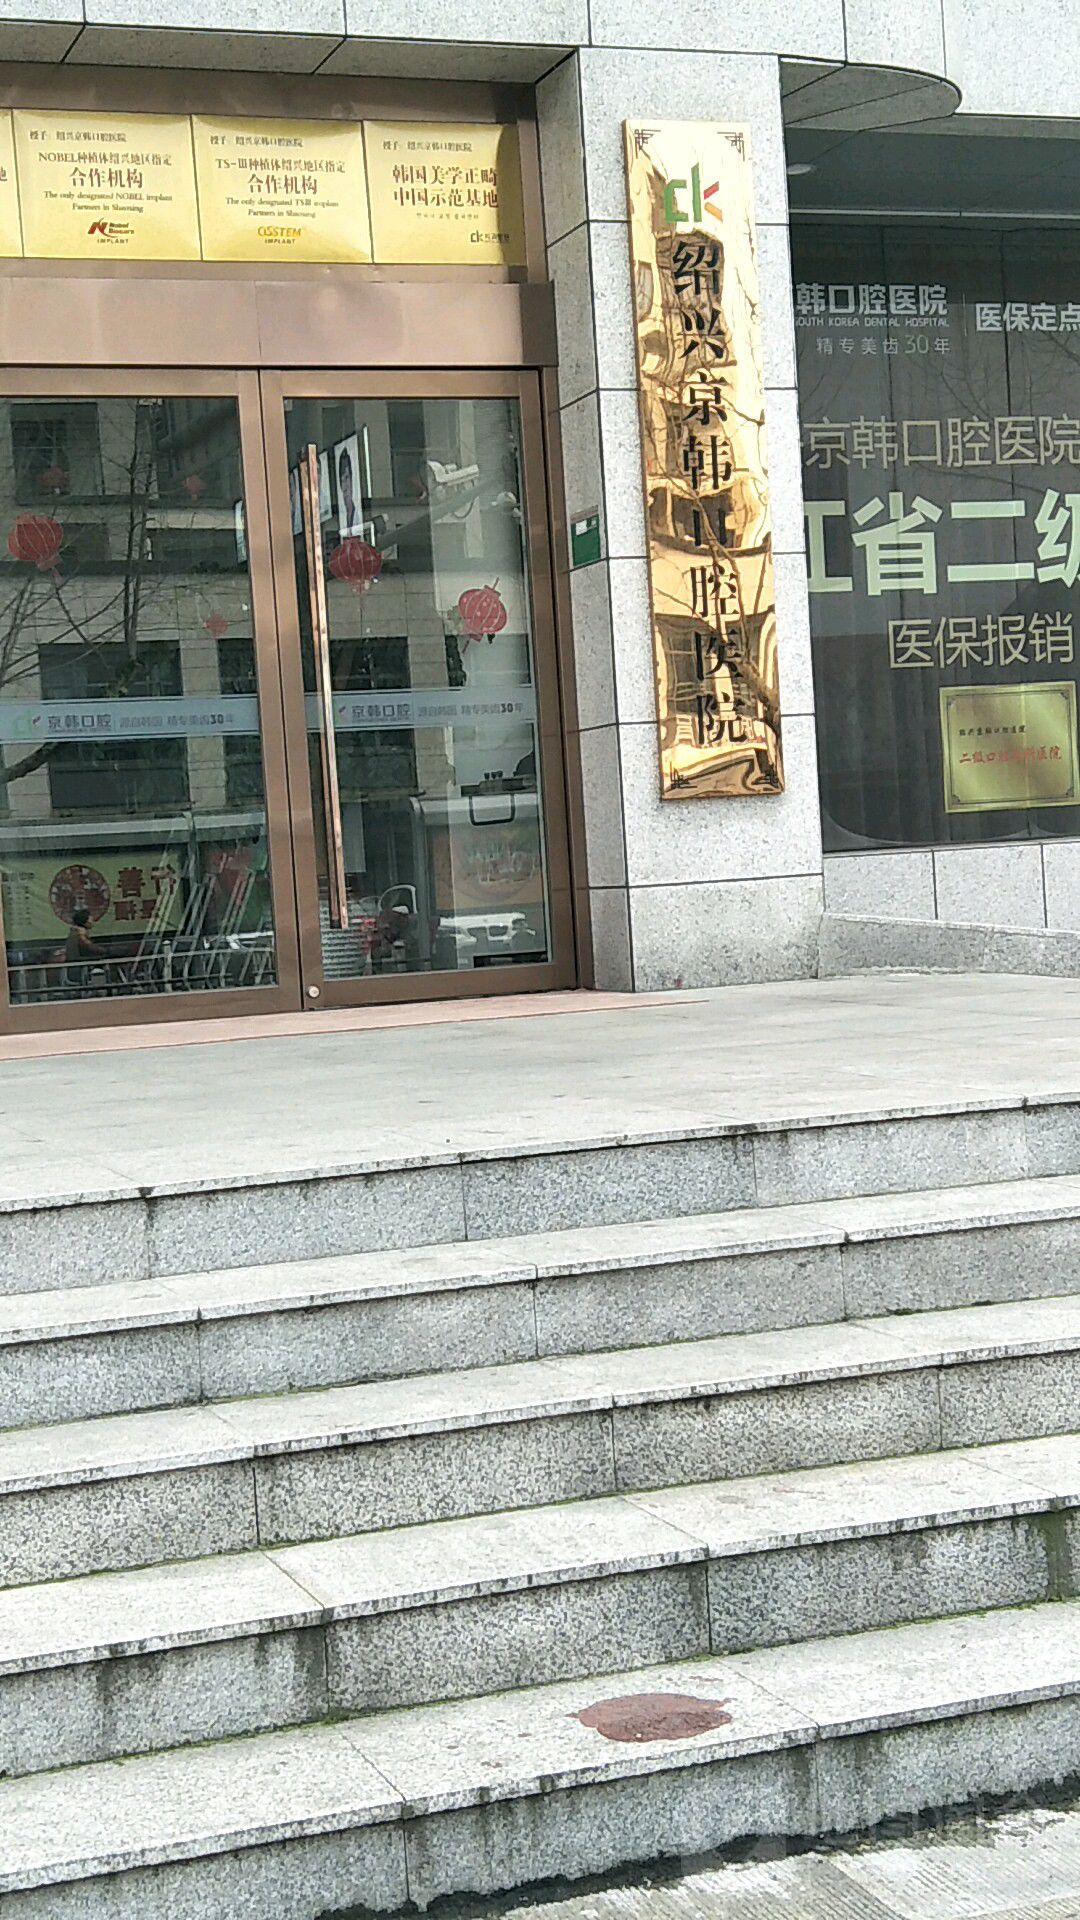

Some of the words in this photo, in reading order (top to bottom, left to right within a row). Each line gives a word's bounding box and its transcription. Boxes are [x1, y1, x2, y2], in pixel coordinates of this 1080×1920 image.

[38, 152, 172, 166] NOBEL种植体绍兴地区指定
[70, 167, 143, 188] 合作机构
[248, 173, 318, 195] 合作机构
[392, 164, 498, 186] 韩国美学正畸
[394, 187, 499, 208] 中国示范基地
[796, 283, 948, 316] 韩口腔医院
[829, 317, 859, 327] KOREA
[865, 317, 900, 327] DENTAL
[905, 317, 950, 327] HOSPITAL
[975, 302, 1080, 332] 医保定点
[803, 413, 1080, 470] 京韩口腔医院
[672, 241, 748, 744] 绍兴京韩口腔医院
[888, 611, 1074, 668] 医保报销
